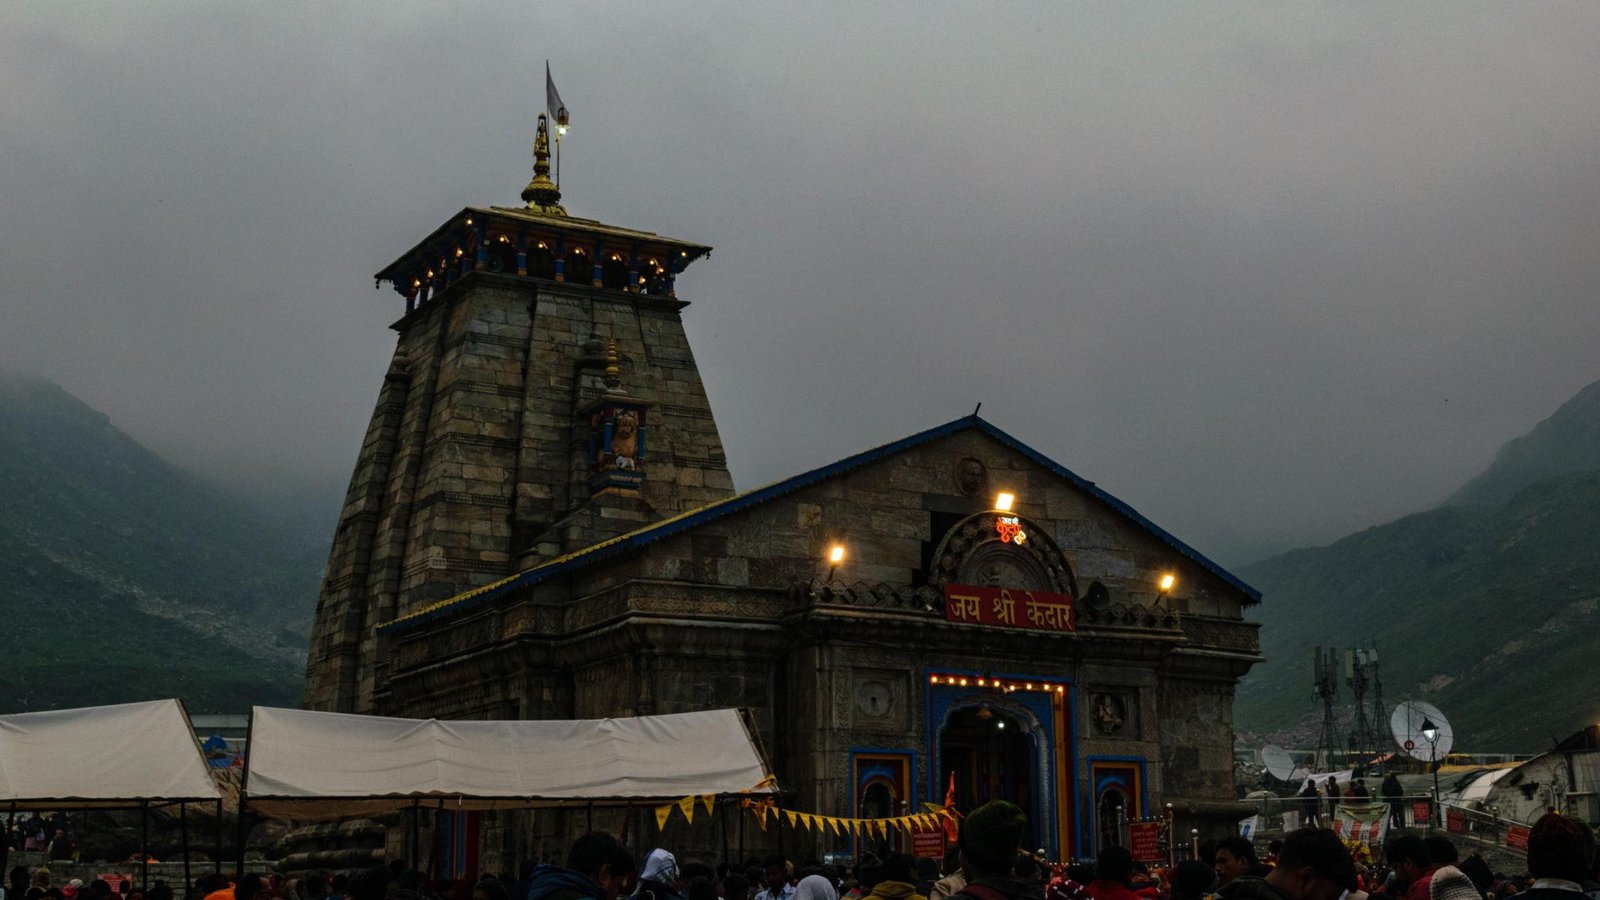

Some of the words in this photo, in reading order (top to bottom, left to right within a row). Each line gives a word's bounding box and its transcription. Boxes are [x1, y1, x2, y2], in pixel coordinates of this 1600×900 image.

[950, 594, 980, 621] जय
[992, 589, 1015, 624] श्री
[1025, 591, 1072, 630] केदार
